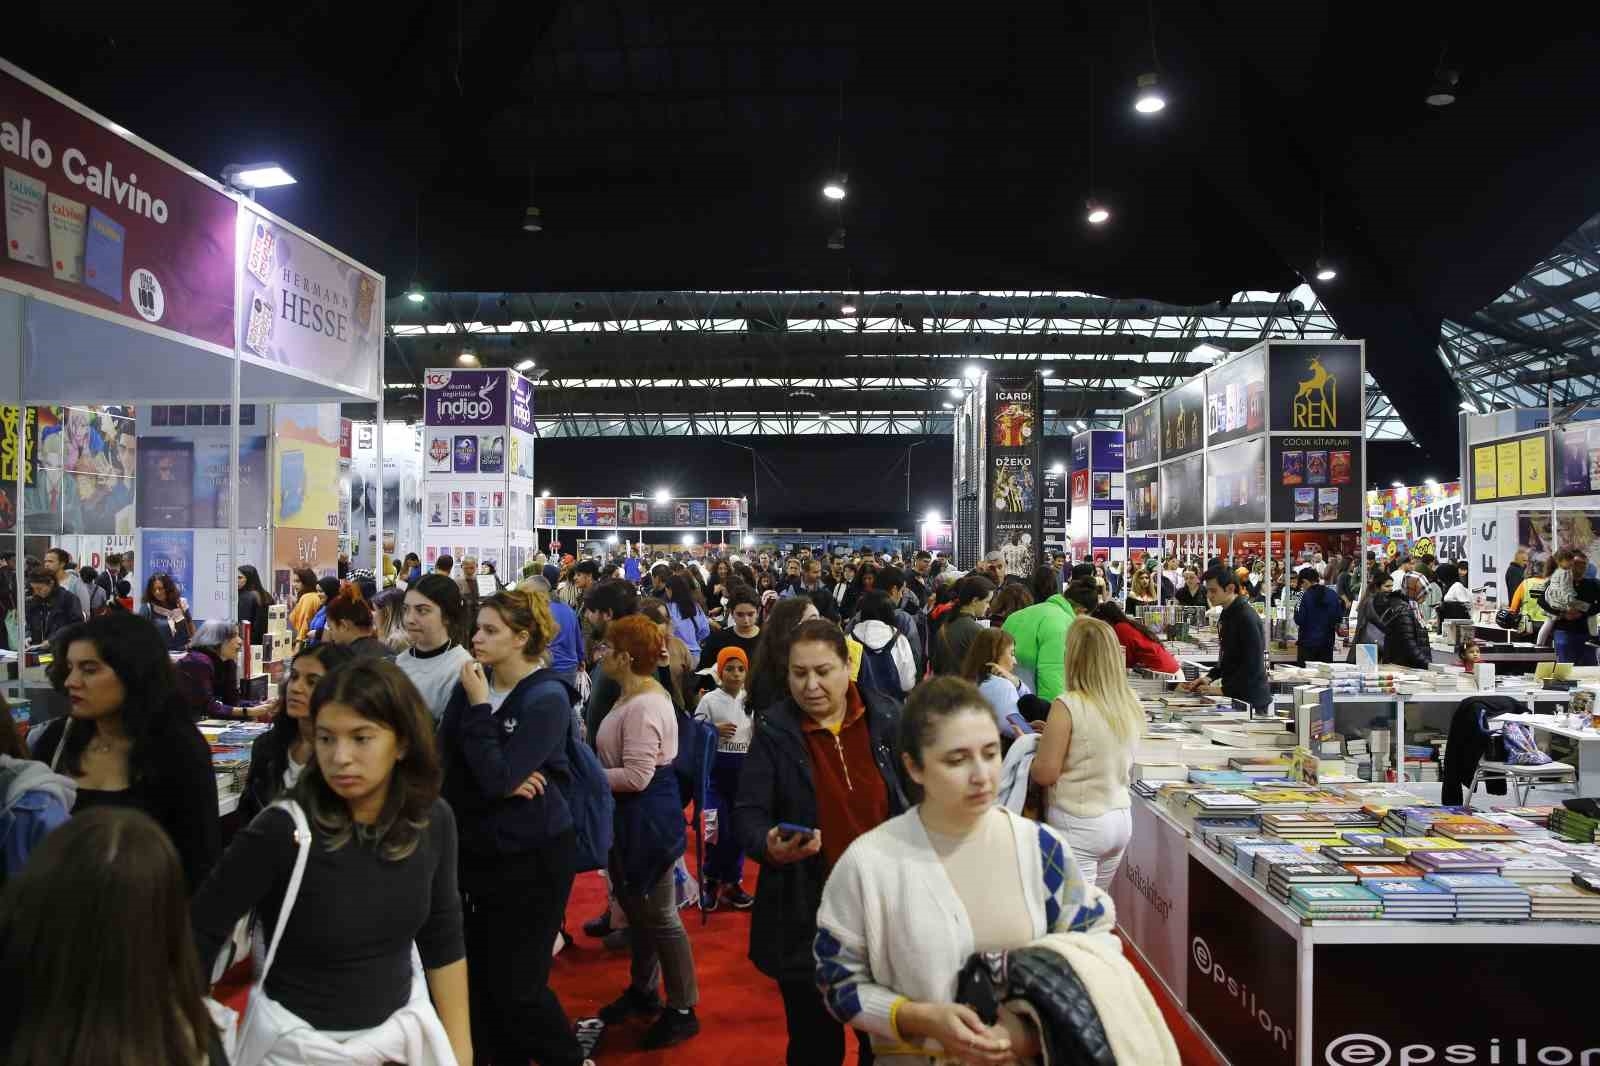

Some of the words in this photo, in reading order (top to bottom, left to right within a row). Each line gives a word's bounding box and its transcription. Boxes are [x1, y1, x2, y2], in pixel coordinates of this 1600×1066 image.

[0, 117, 52, 168] alo
[62, 148, 168, 223] Calvino
[283, 268, 348, 309] HERMANN
[281, 289, 348, 342] HESSE
[436, 398, 492, 421] indigo
[1293, 398, 1337, 428] REN
[1192, 936, 1287, 1051] epsilon
